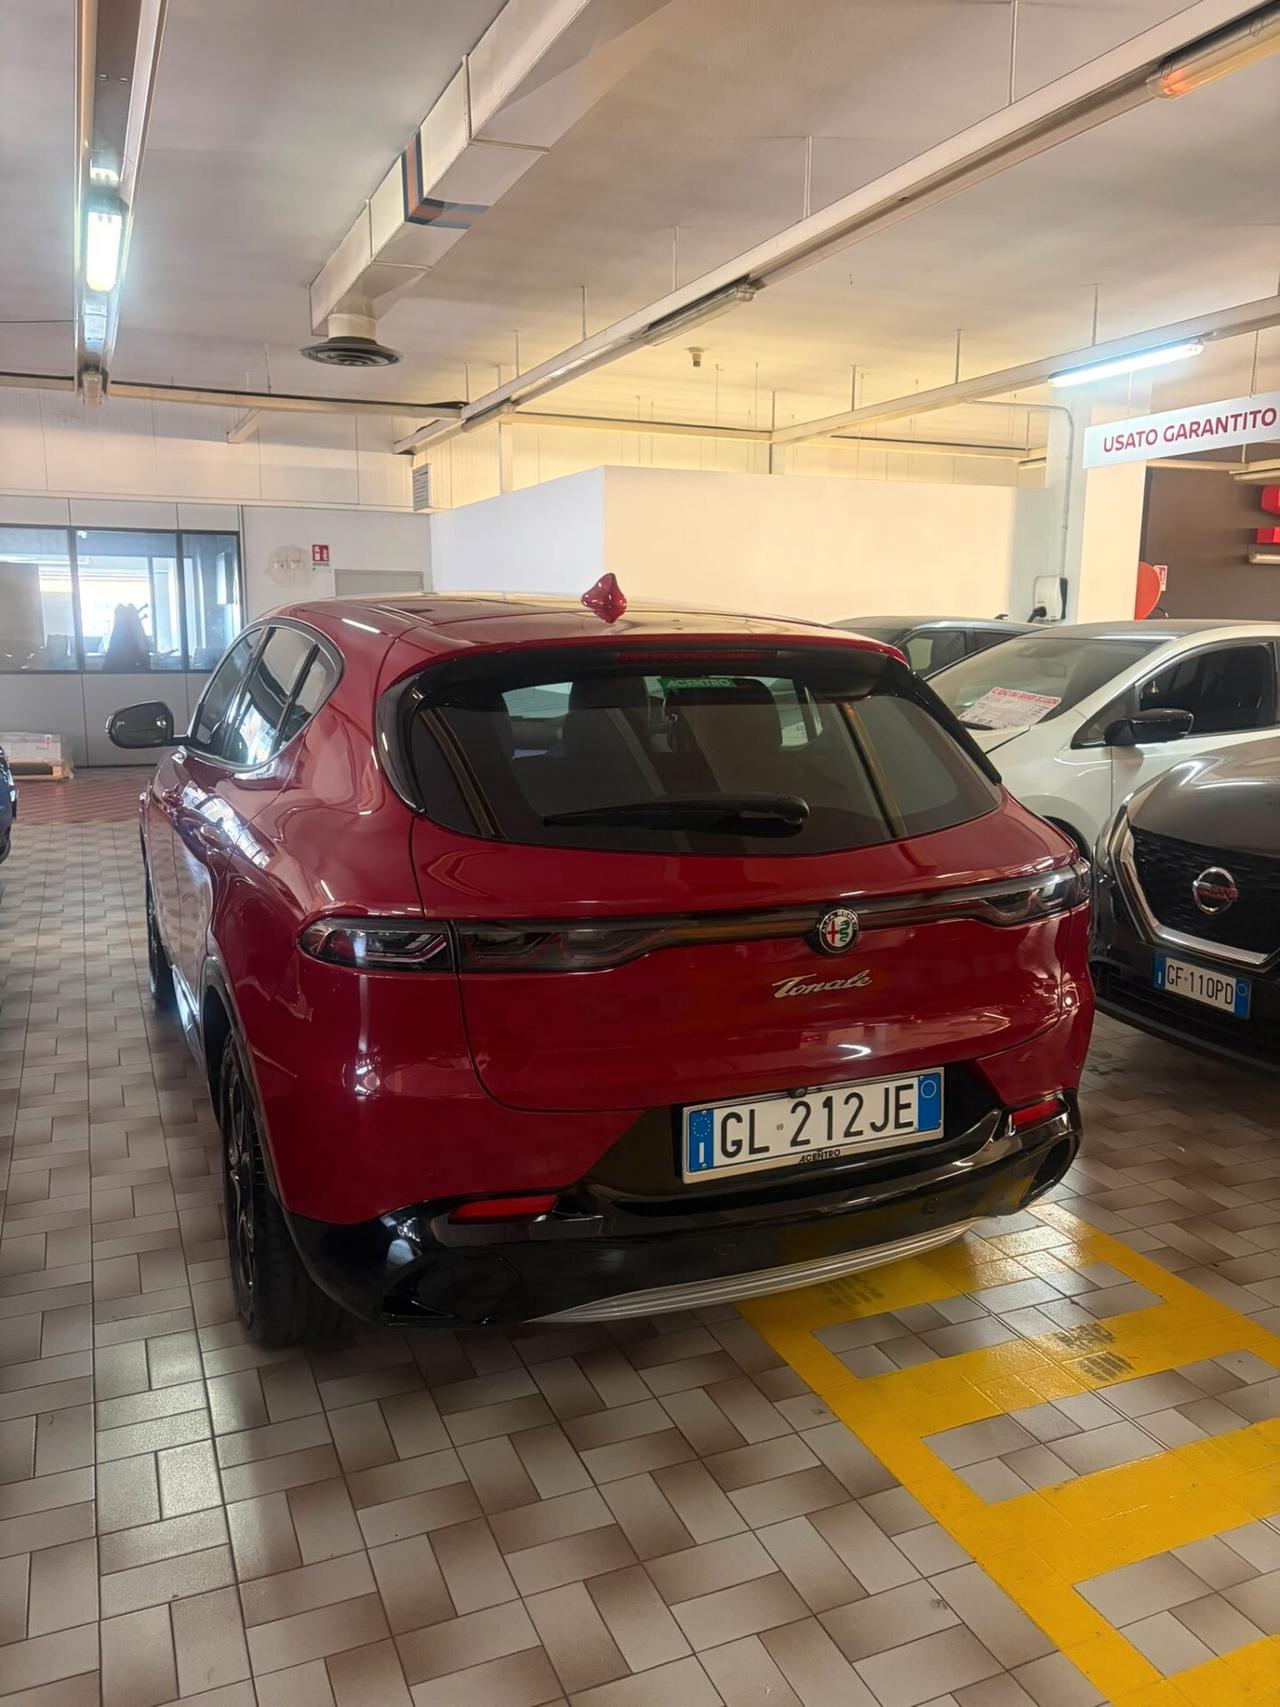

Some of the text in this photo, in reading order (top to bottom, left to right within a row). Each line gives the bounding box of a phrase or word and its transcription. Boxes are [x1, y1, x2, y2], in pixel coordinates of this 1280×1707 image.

[1103, 407, 1277, 453] USATO GARANTITO
[772, 969, 873, 999] Tonale
[720, 1109, 770, 1158] GL
[789, 1083, 915, 1147] 212JE
